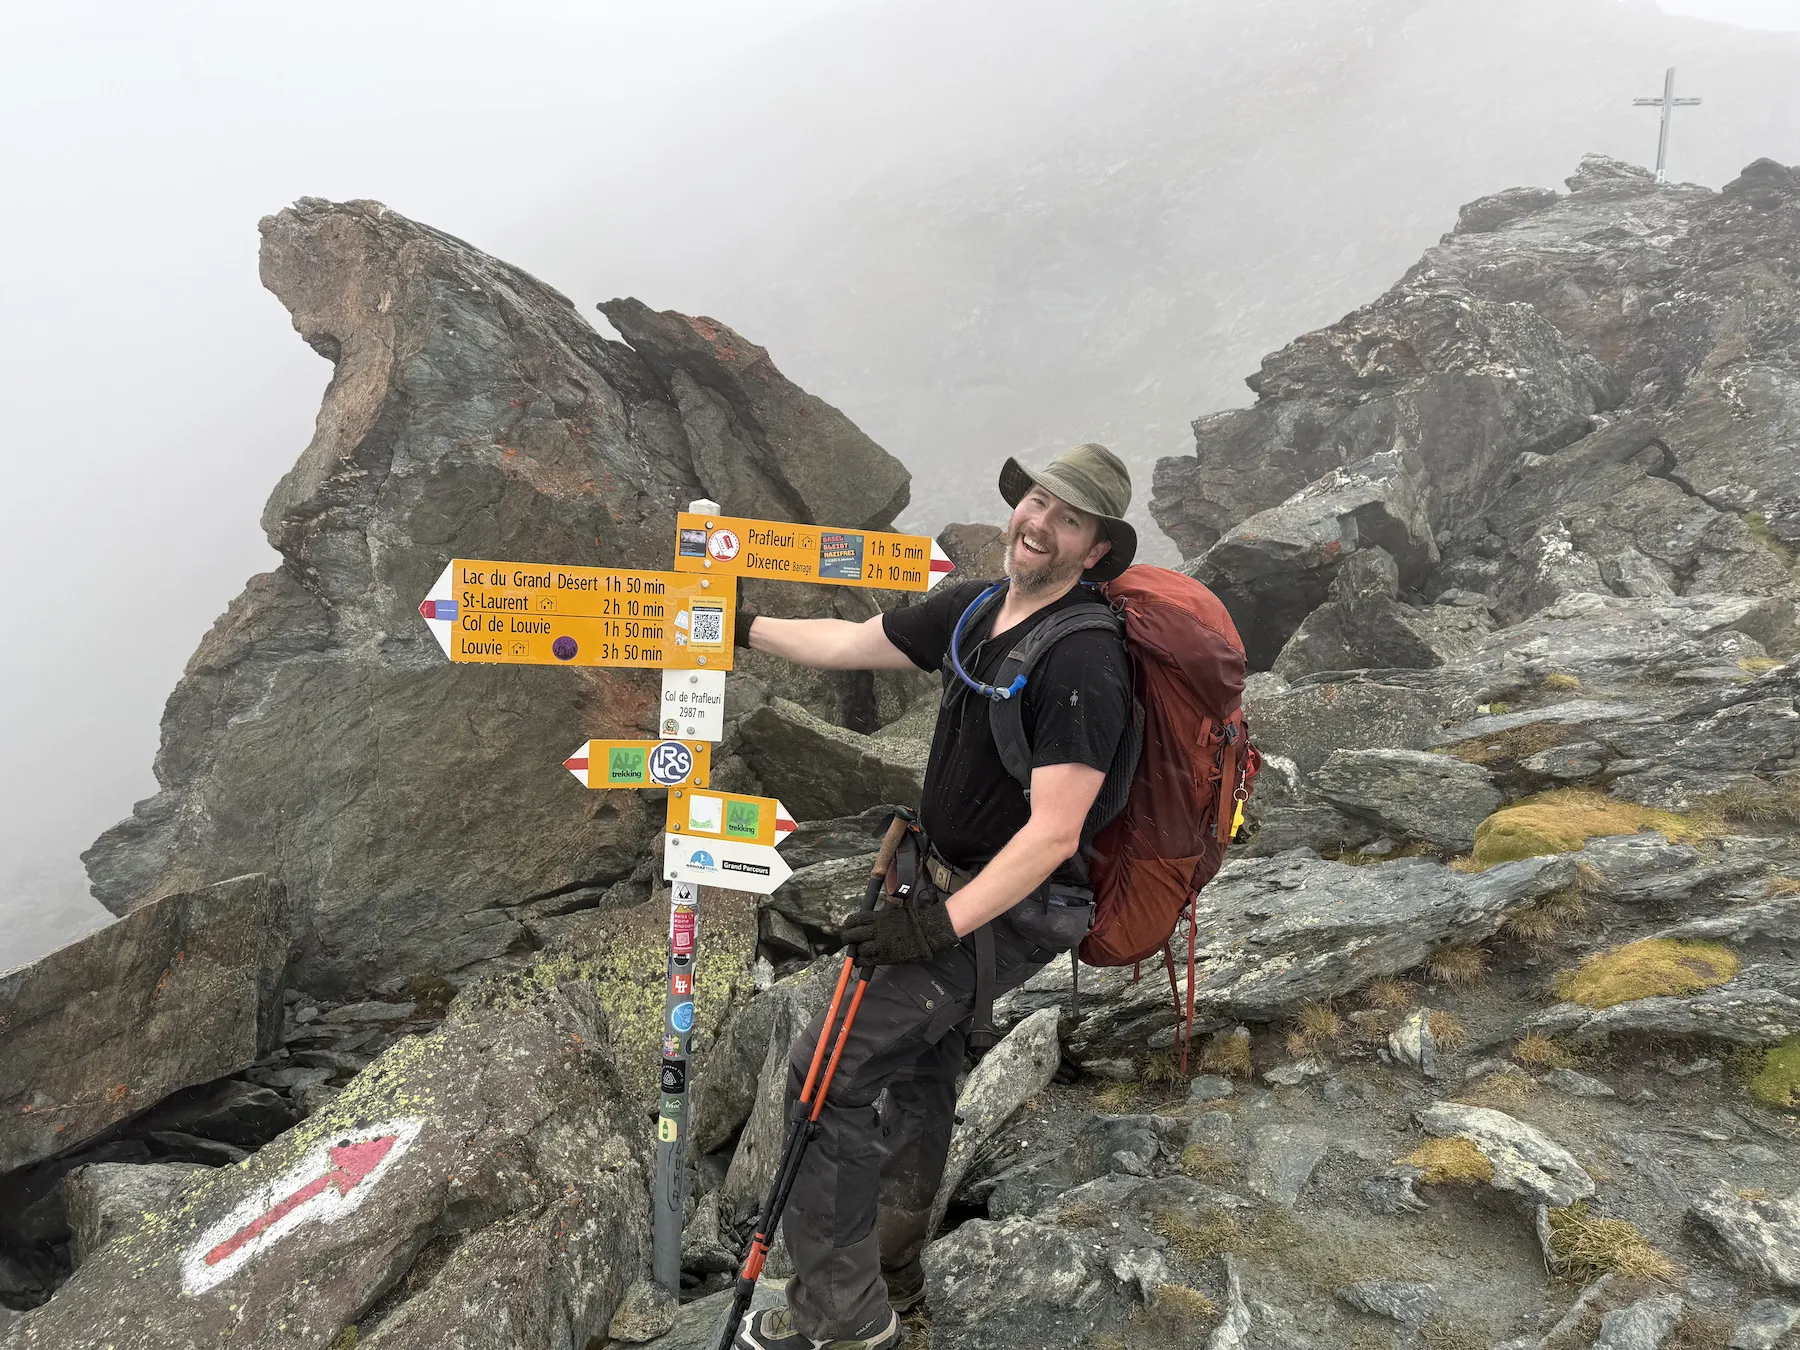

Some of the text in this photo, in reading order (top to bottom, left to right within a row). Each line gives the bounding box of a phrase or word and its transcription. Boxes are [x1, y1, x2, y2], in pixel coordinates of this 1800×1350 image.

[749, 529, 795, 548] Prafleuri
[872, 541, 923, 559] 1 h 15 min
[747, 554, 812, 574] Dixence Barrage
[463, 568, 598, 591] Lac du Grand Désert
[868, 564, 921, 583] 2 h 10 min
[605, 576, 665, 595] 1 h 50 min
[463, 592, 528, 611] St-Laurent
[603, 599, 664, 617] 2 h 10 min
[463, 615, 551, 634] Col de Louvie
[604, 621, 663, 639] 1 h 50 min
[462, 638, 502, 655] Louvie
[602, 643, 662, 661] 3 h 50 min
[665, 690, 721, 704] Col de Prafleuri
[679, 707, 704, 718] 2987 m
[612, 751, 642, 770] ALP
[612, 770, 641, 778] trekking
[729, 805, 757, 825] ALP
[729, 824, 755, 833] trekking
[723, 861, 769, 875] Grand Parcours
